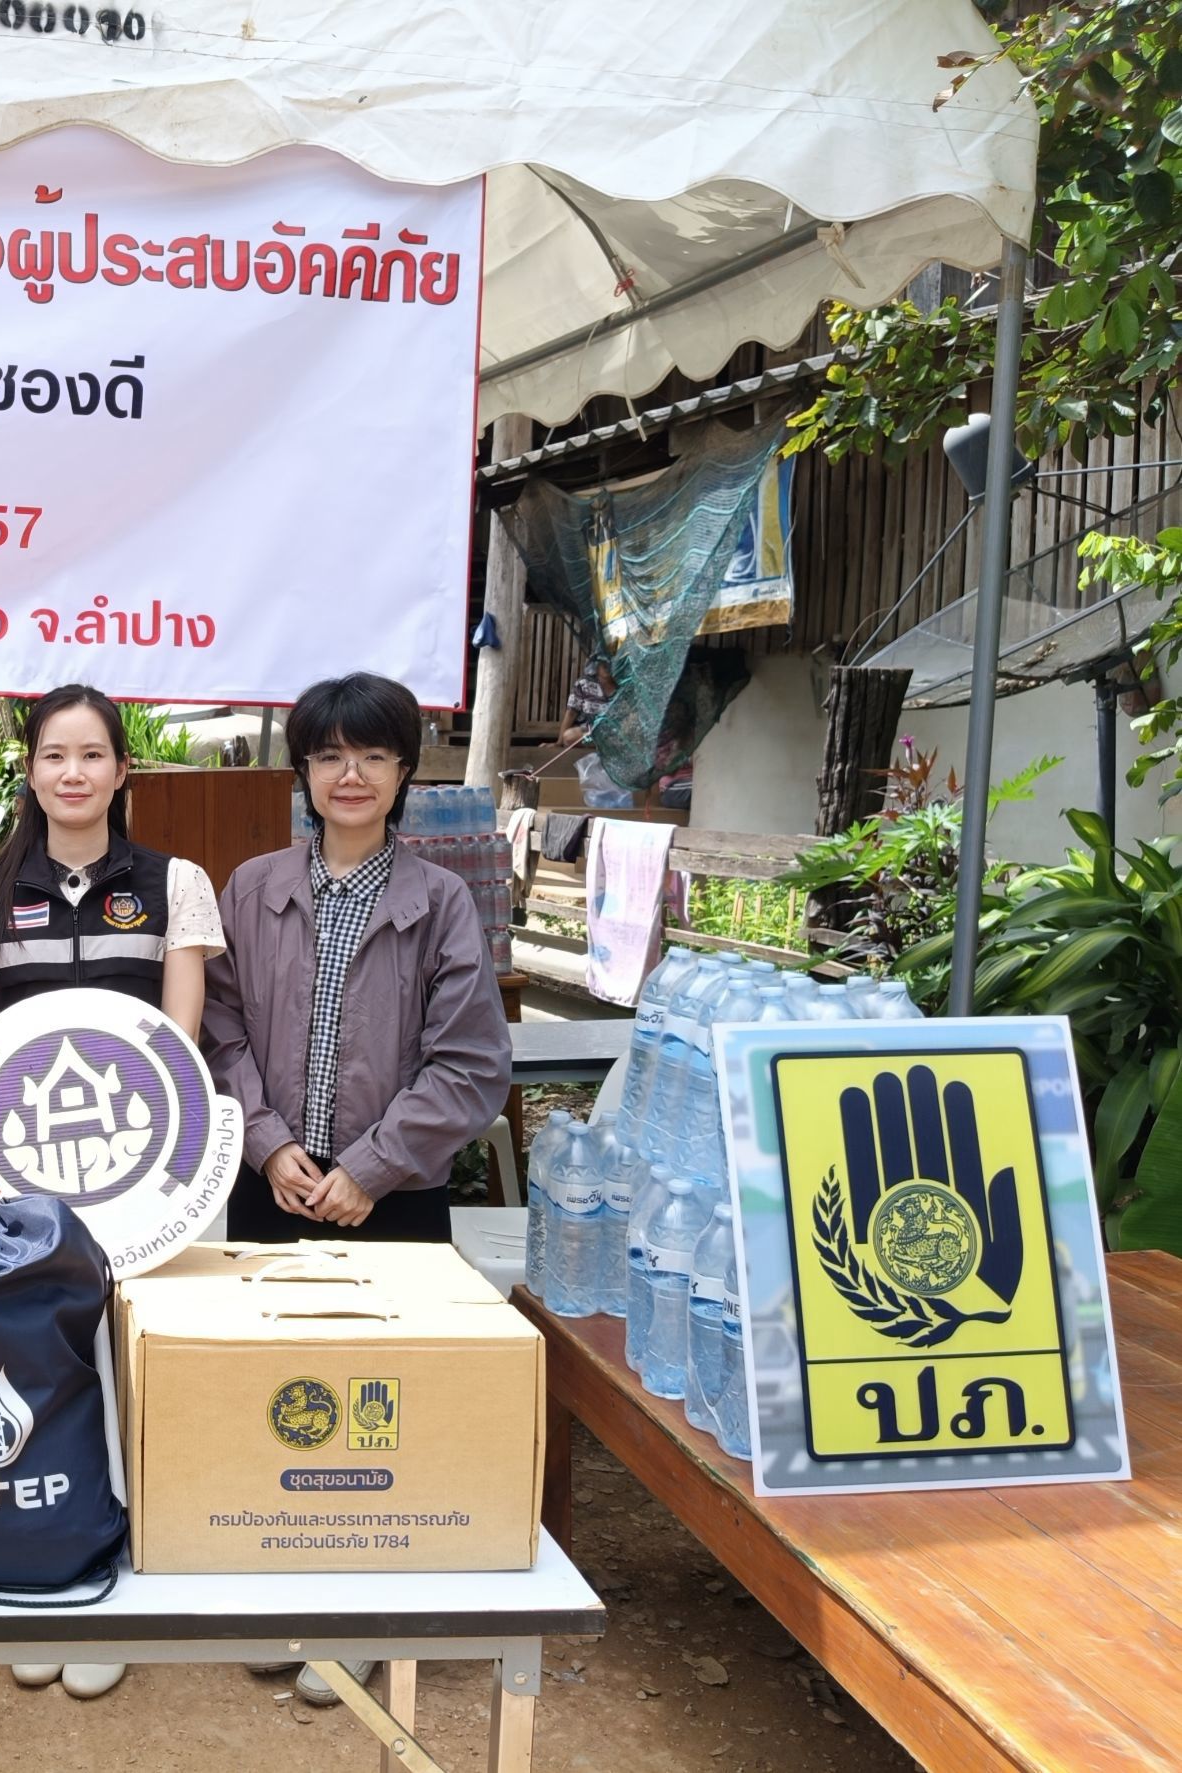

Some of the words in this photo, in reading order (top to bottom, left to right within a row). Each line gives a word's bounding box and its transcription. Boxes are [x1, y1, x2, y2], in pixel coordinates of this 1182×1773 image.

[30, 595, 215, 647] จ.ลำปาง
[184, 1108, 235, 1219] จังหวัดลำปาง
[856, 1366, 1045, 1444] ปภ.
[356, 1434, 393, 1448] ปภ.
[289, 1470, 388, 1490] ชุดสุขอนามัย
[209, 1510, 470, 1528] กรมป้องกันและบรรเทาสาธารณภัย
[261, 1533, 368, 1550] สายด่วนนิรภัย
[373, 1535, 410, 1549] 1784
